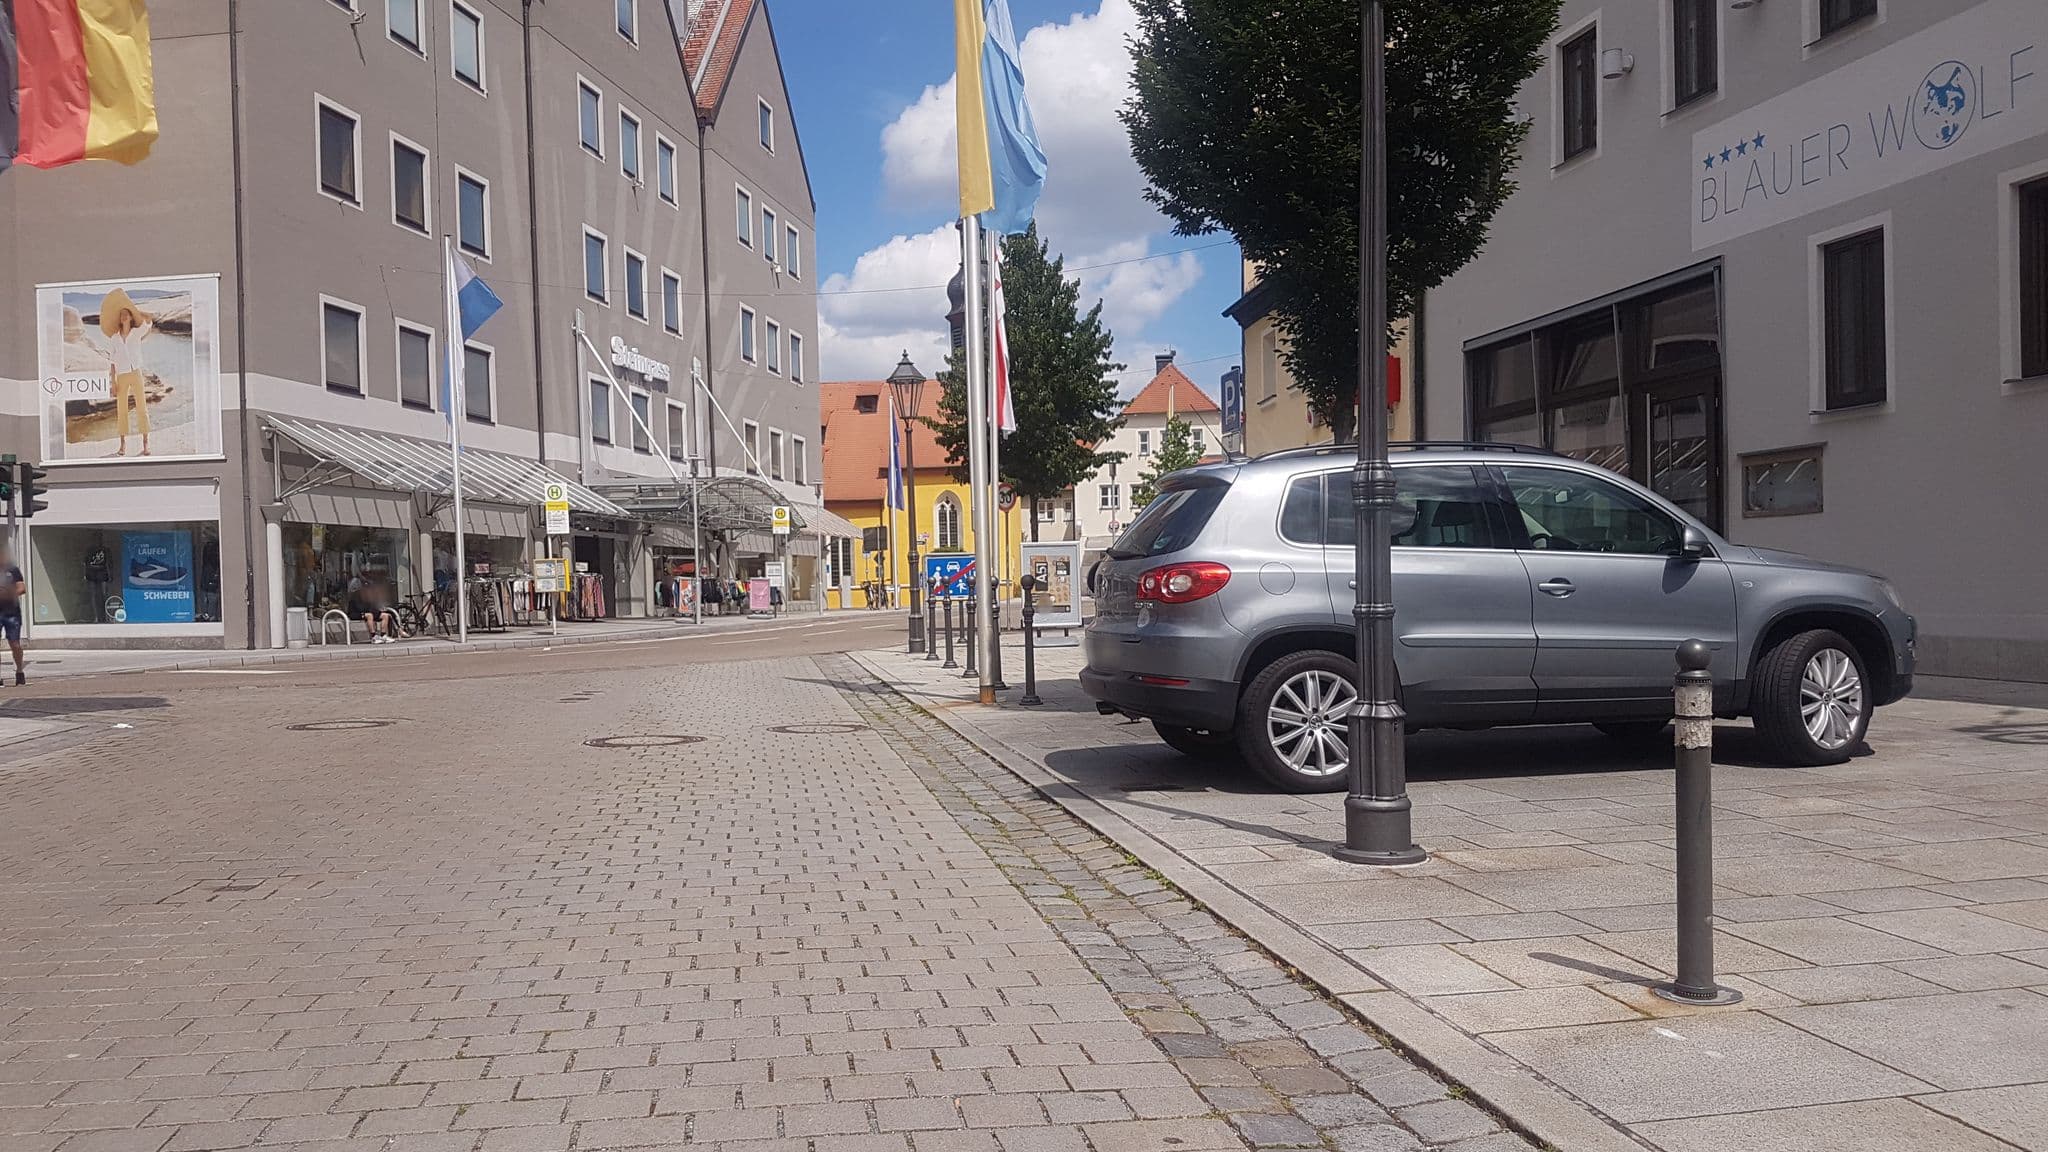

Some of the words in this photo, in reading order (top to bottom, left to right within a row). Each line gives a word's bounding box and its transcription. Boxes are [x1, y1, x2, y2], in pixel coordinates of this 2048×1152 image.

[1701, 123, 1850, 223] BLAUER
[1868, 45, 2034, 157] WOLF
[66, 378, 107, 393] TONI
[1224, 379, 1236, 425] P
[999, 490, 1012, 504] 30
[138, 547, 167, 555] LAUFEN
[143, 591, 190, 600] SCHWEBEN
